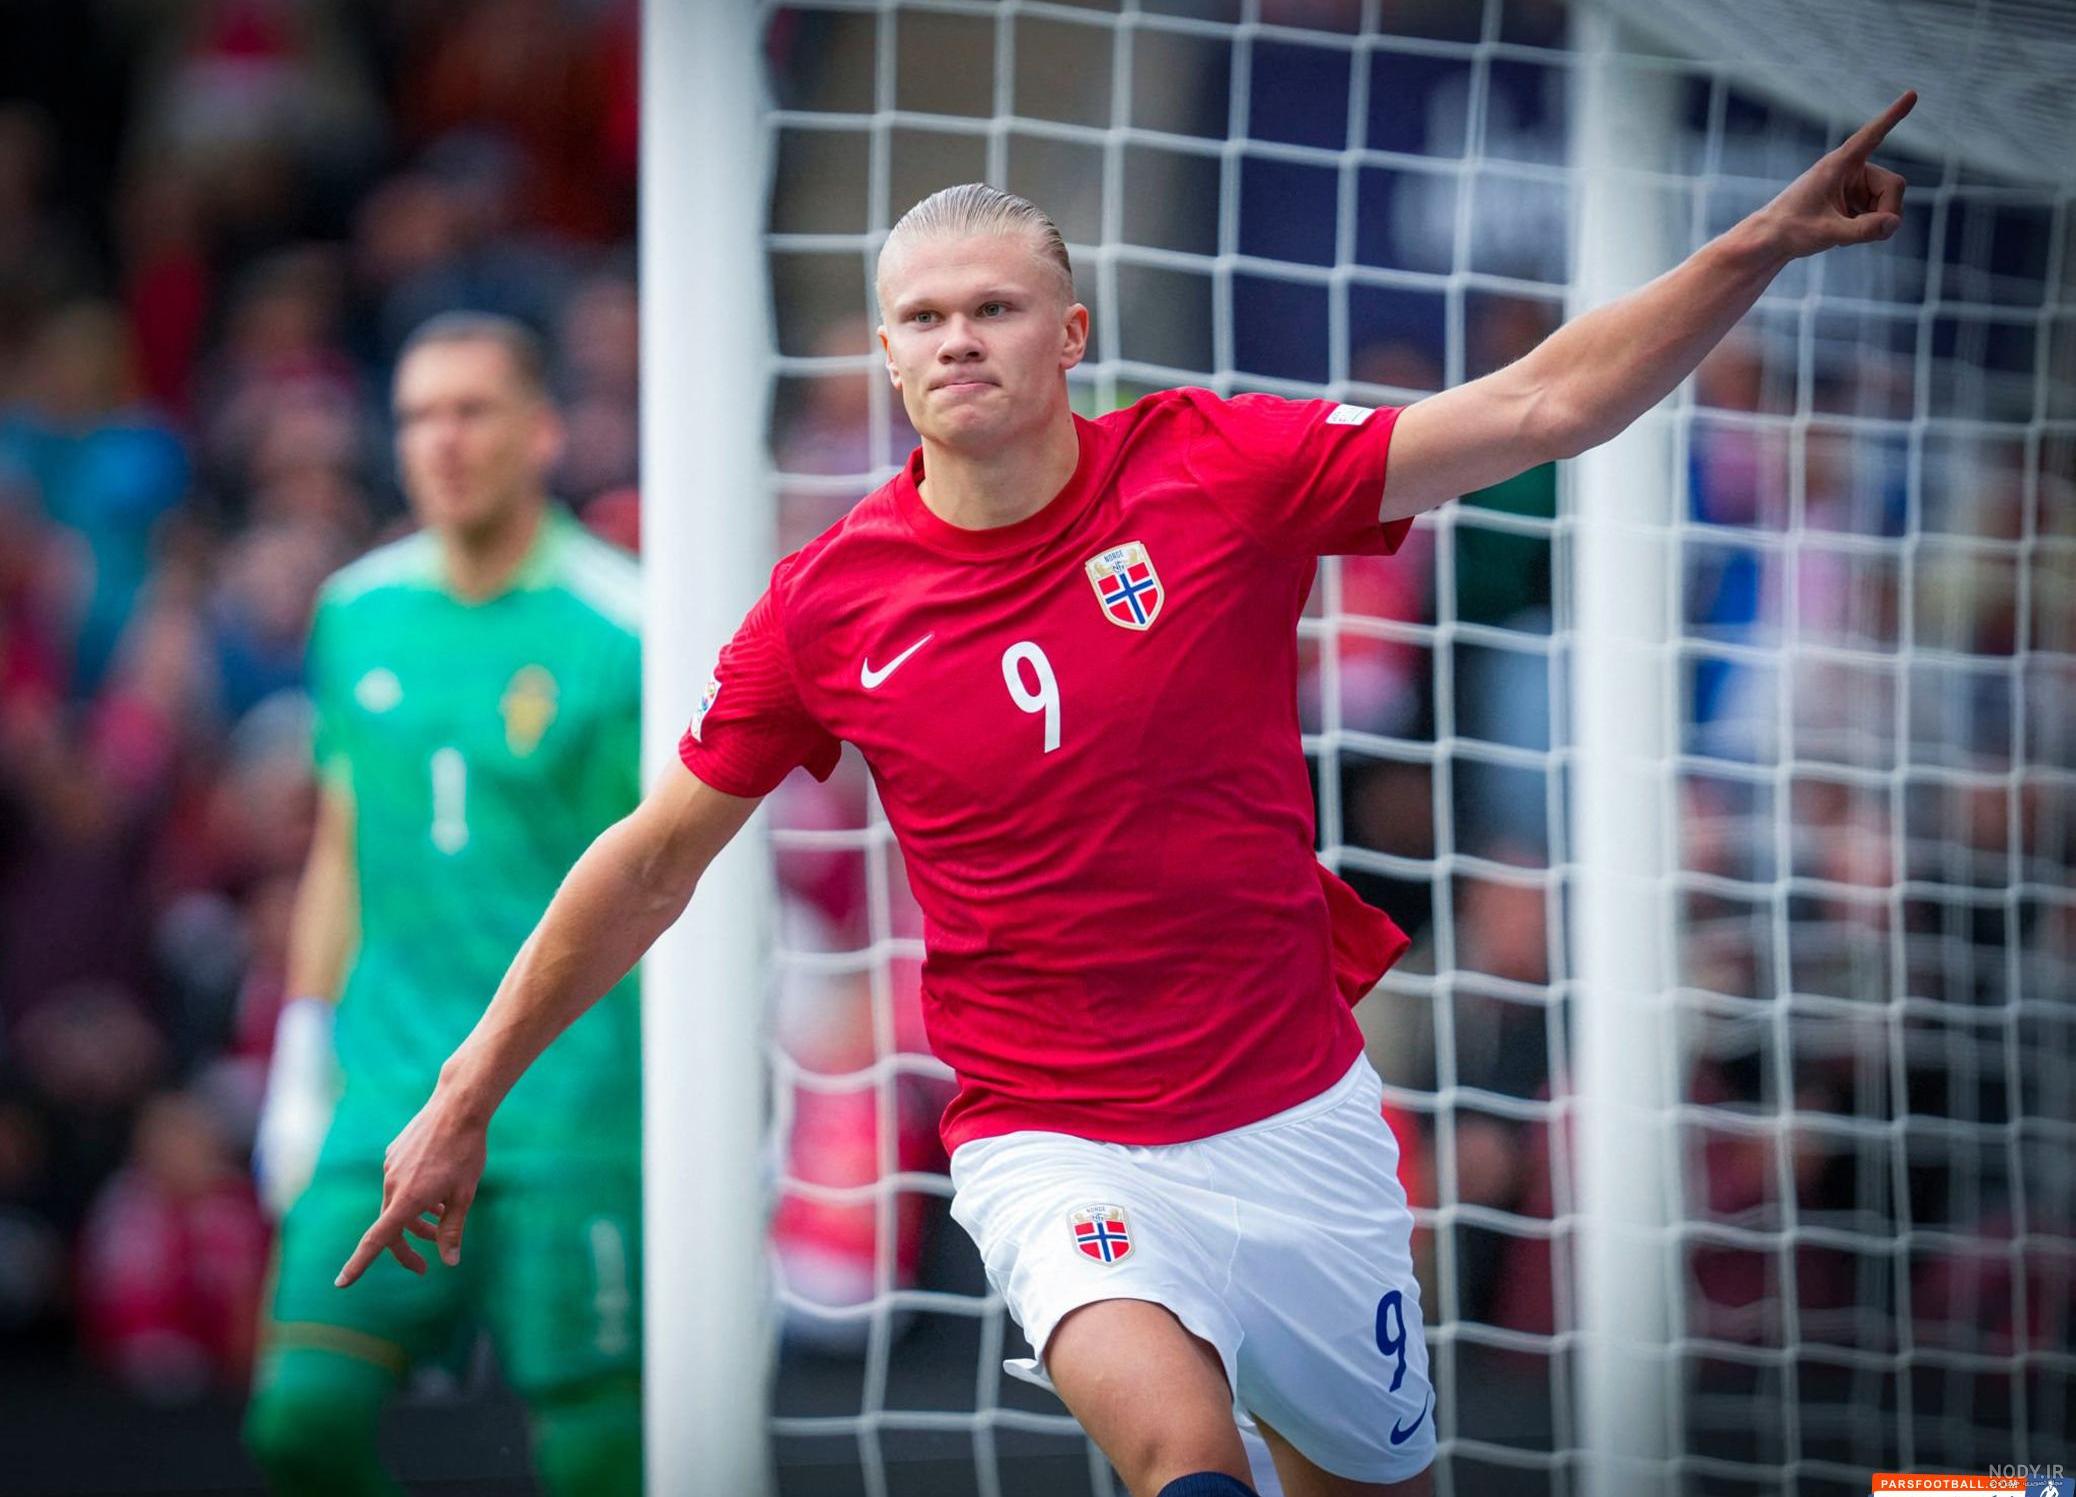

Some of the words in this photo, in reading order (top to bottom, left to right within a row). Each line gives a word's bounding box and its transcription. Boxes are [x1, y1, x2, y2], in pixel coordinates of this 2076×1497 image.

[1002, 641, 1060, 753] 9
[429, 747, 469, 855] 1
[1376, 1289, 1406, 1393] 9
